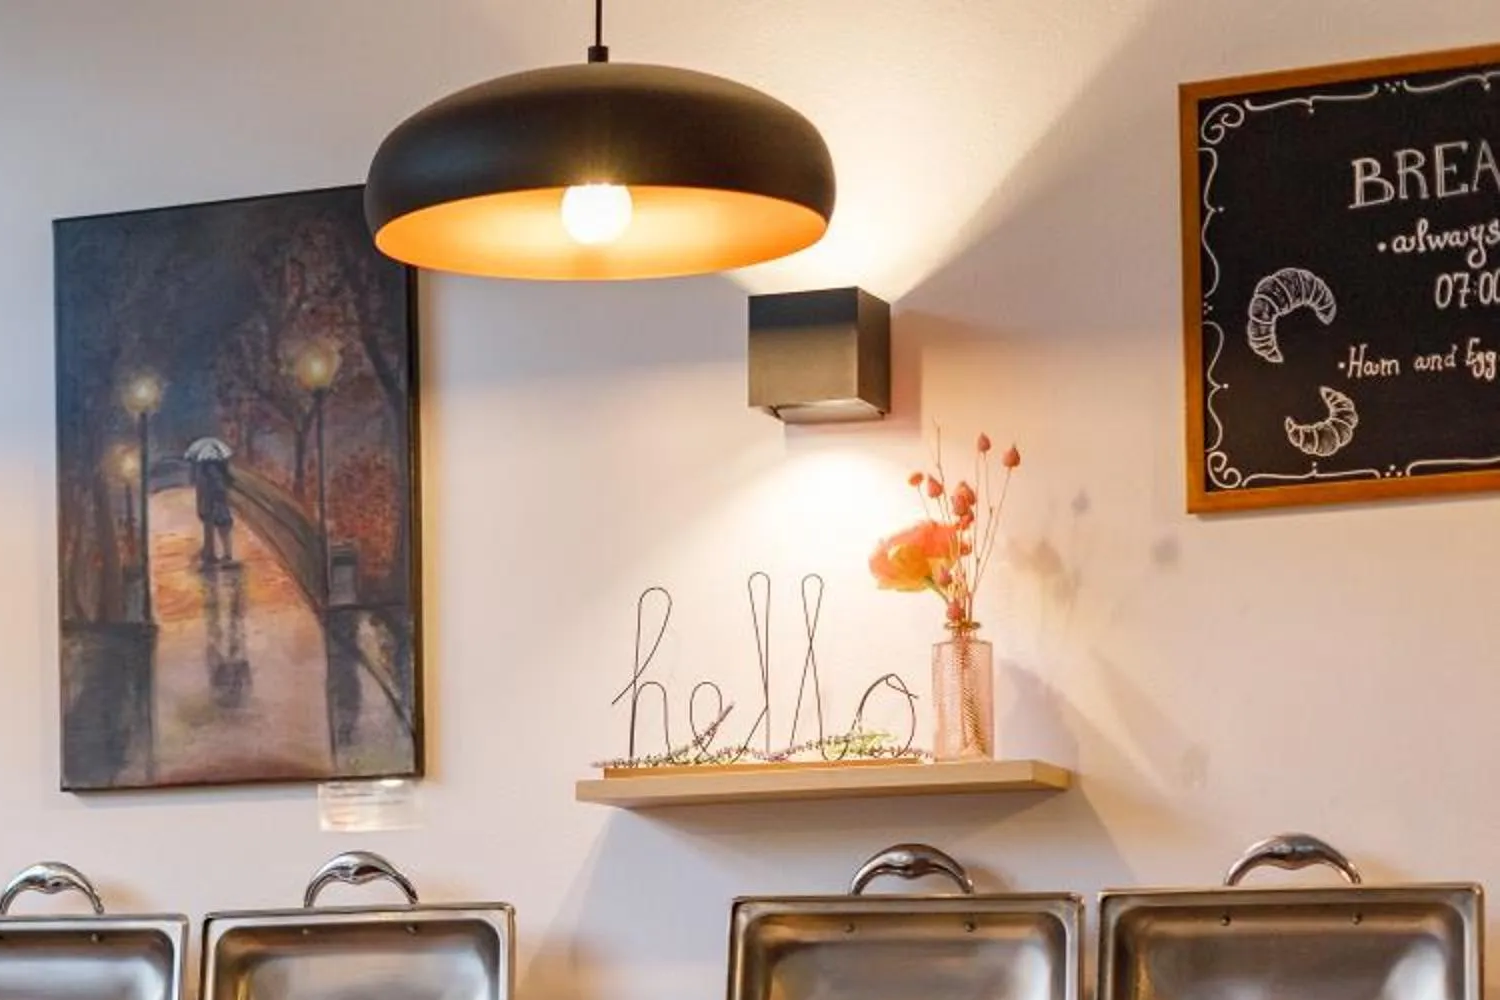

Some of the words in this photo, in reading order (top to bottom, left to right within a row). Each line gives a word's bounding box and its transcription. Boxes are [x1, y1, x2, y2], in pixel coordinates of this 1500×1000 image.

[1348, 138, 1500, 209] BREA
[1392, 217, 1500, 269] always
[1347, 343, 1400, 379] Ham
[1413, 344, 1458, 371] and
[1465, 337, 1497, 381] Egg
[612, 572, 920, 763] hello
